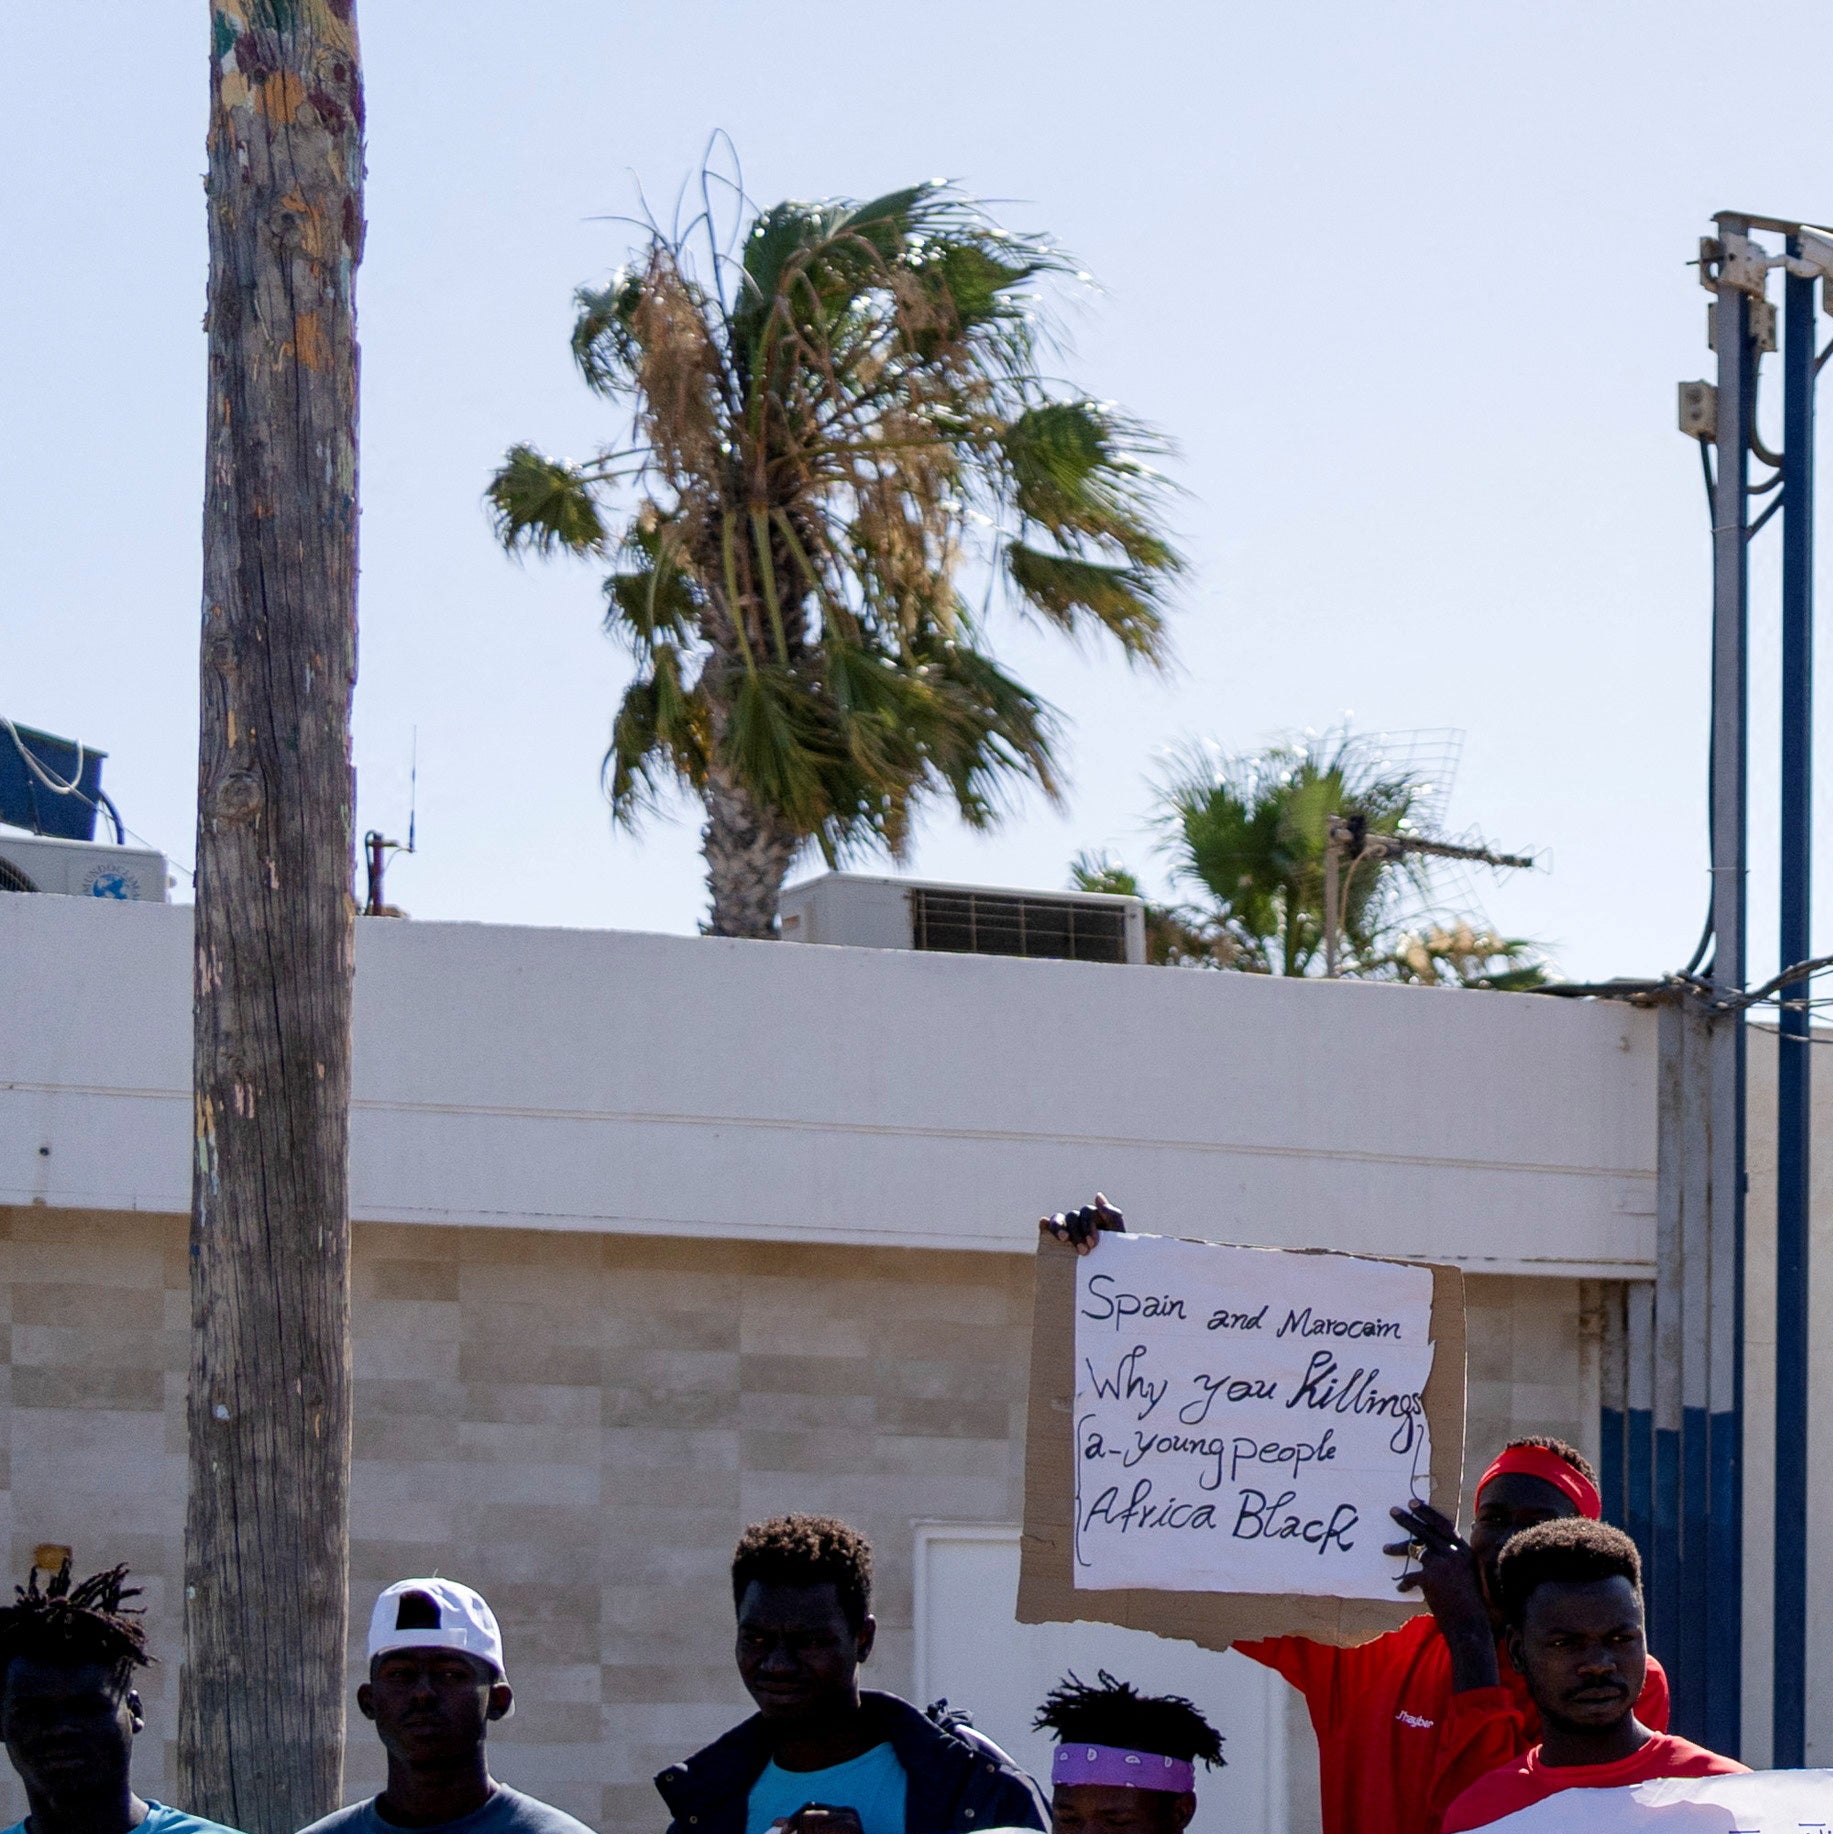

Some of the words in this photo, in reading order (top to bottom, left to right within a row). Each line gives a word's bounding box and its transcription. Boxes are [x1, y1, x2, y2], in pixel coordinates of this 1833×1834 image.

[1081, 1274, 1187, 1331] Spain
[1206, 1305, 1270, 1332] and
[1085, 1345, 1170, 1420] Why
[1178, 1374, 1278, 1425] you
[1231, 1428, 1337, 1482] people
[1082, 1479, 1217, 1534] Africa
